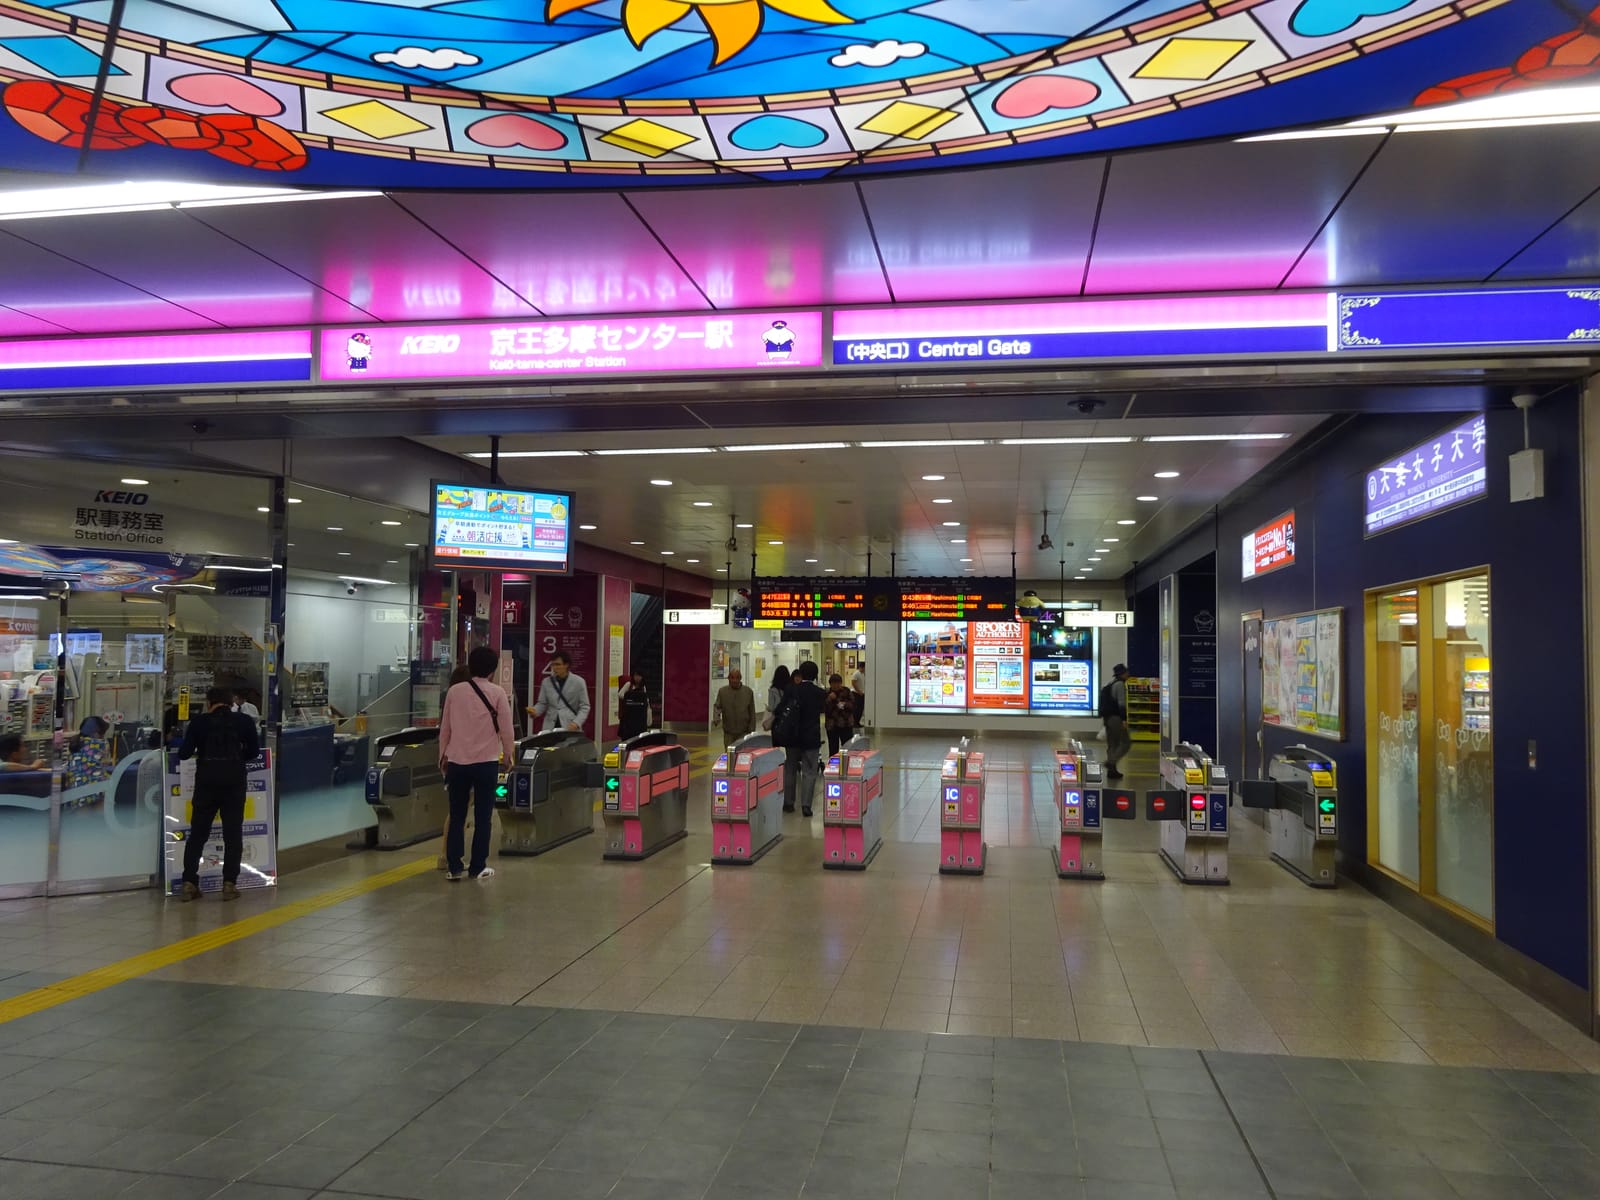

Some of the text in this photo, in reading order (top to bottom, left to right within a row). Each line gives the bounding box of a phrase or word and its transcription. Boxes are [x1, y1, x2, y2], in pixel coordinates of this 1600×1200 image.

[400, 334, 461, 355] KEIO
[489, 320, 734, 356] 京王多摩センター駅
[918, 339, 1032, 358] Central Gate
[586, 355, 627, 368] Station
[1379, 419, 1486, 494] 大妻女子大学
[94, 489, 149, 505] KEIO
[75, 507, 164, 531] 駅事務室
[74, 529, 164, 544] Station Office
[975, 622, 1021, 632] SPORTS
[543, 636, 557, 654] 3
[715, 780, 728, 793] IC
[828, 784, 841, 797] IC
[945, 787, 959, 801] IC
[1065, 791, 1079, 805] IC
